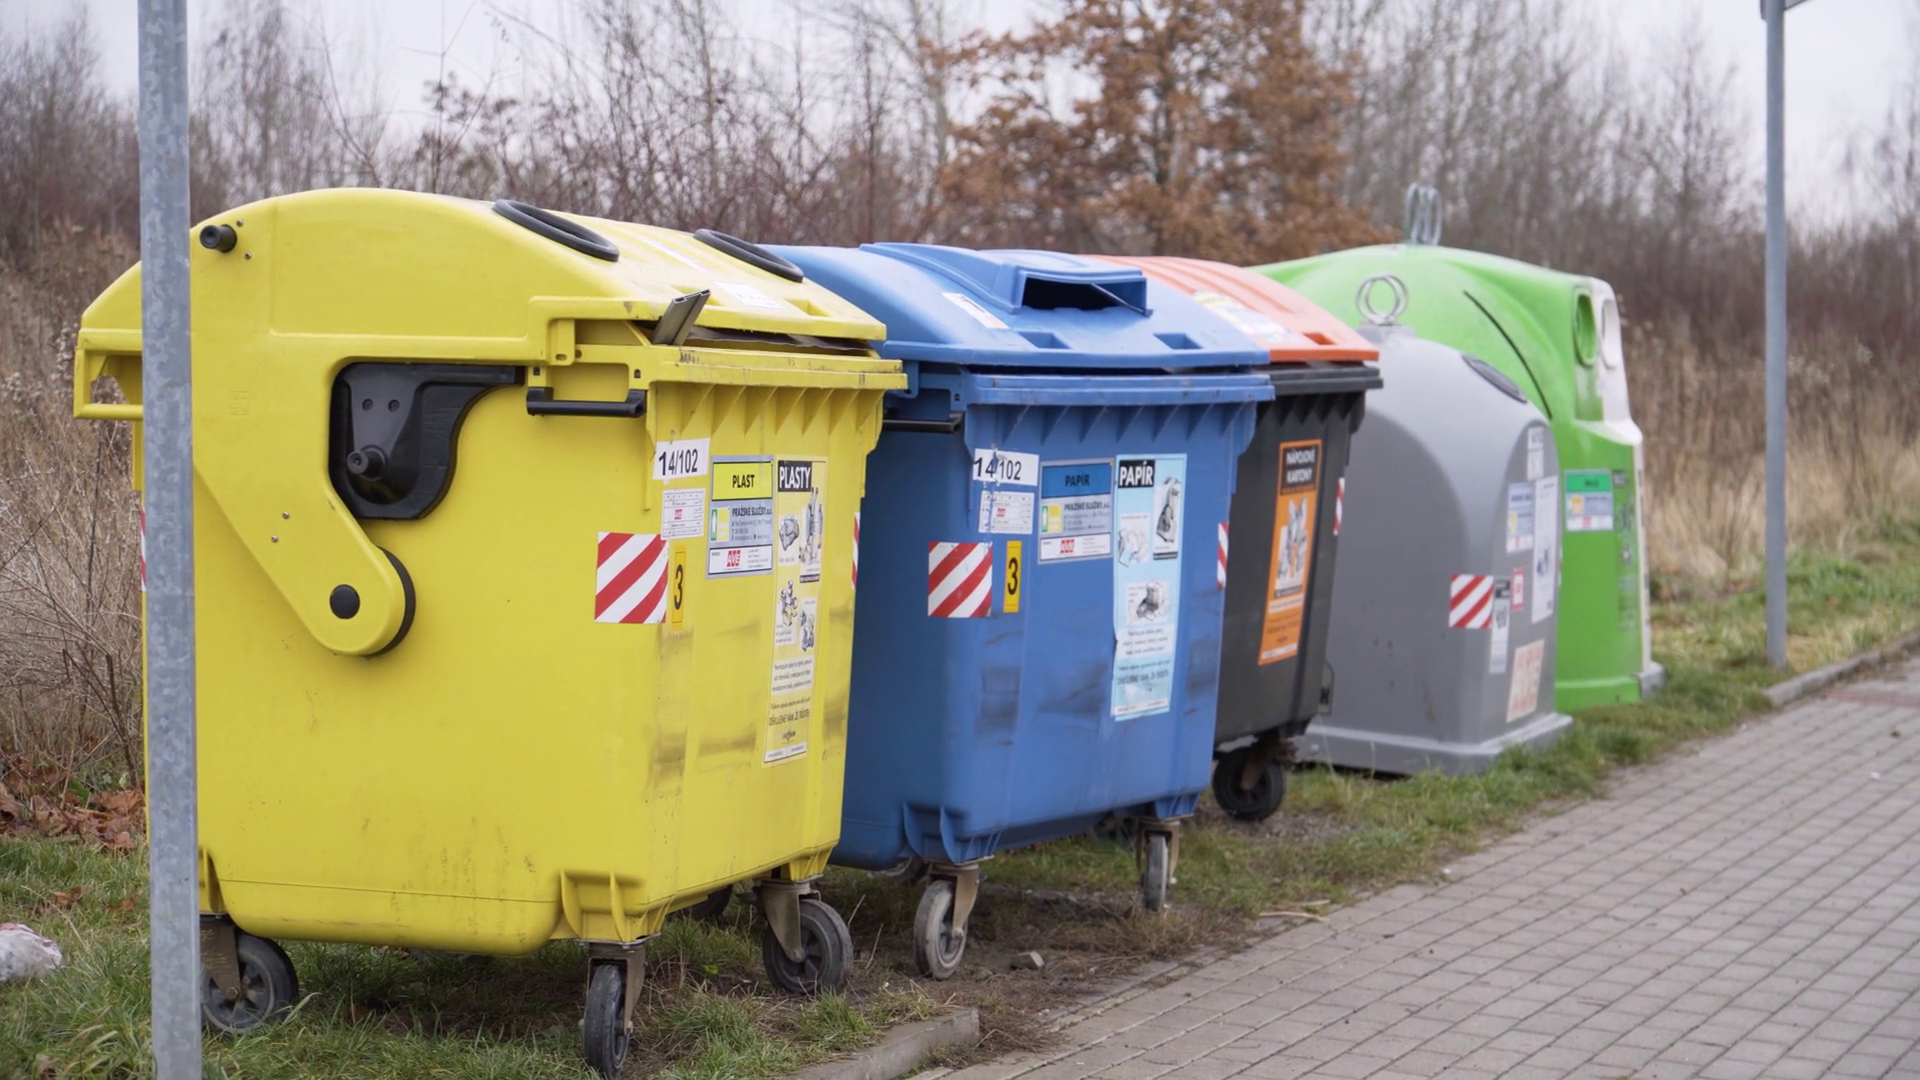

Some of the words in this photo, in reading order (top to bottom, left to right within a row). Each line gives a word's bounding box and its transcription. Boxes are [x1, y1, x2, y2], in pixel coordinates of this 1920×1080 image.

[658, 449, 698, 476] 14/102
[1119, 461, 1153, 486] PAPÍR
[732, 474, 755, 488] PLAST
[779, 466, 811, 489] PLASTY
[1065, 472, 1090, 487] PAPÍR
[674, 563, 684, 610] 3
[1007, 557, 1018, 596] 3
